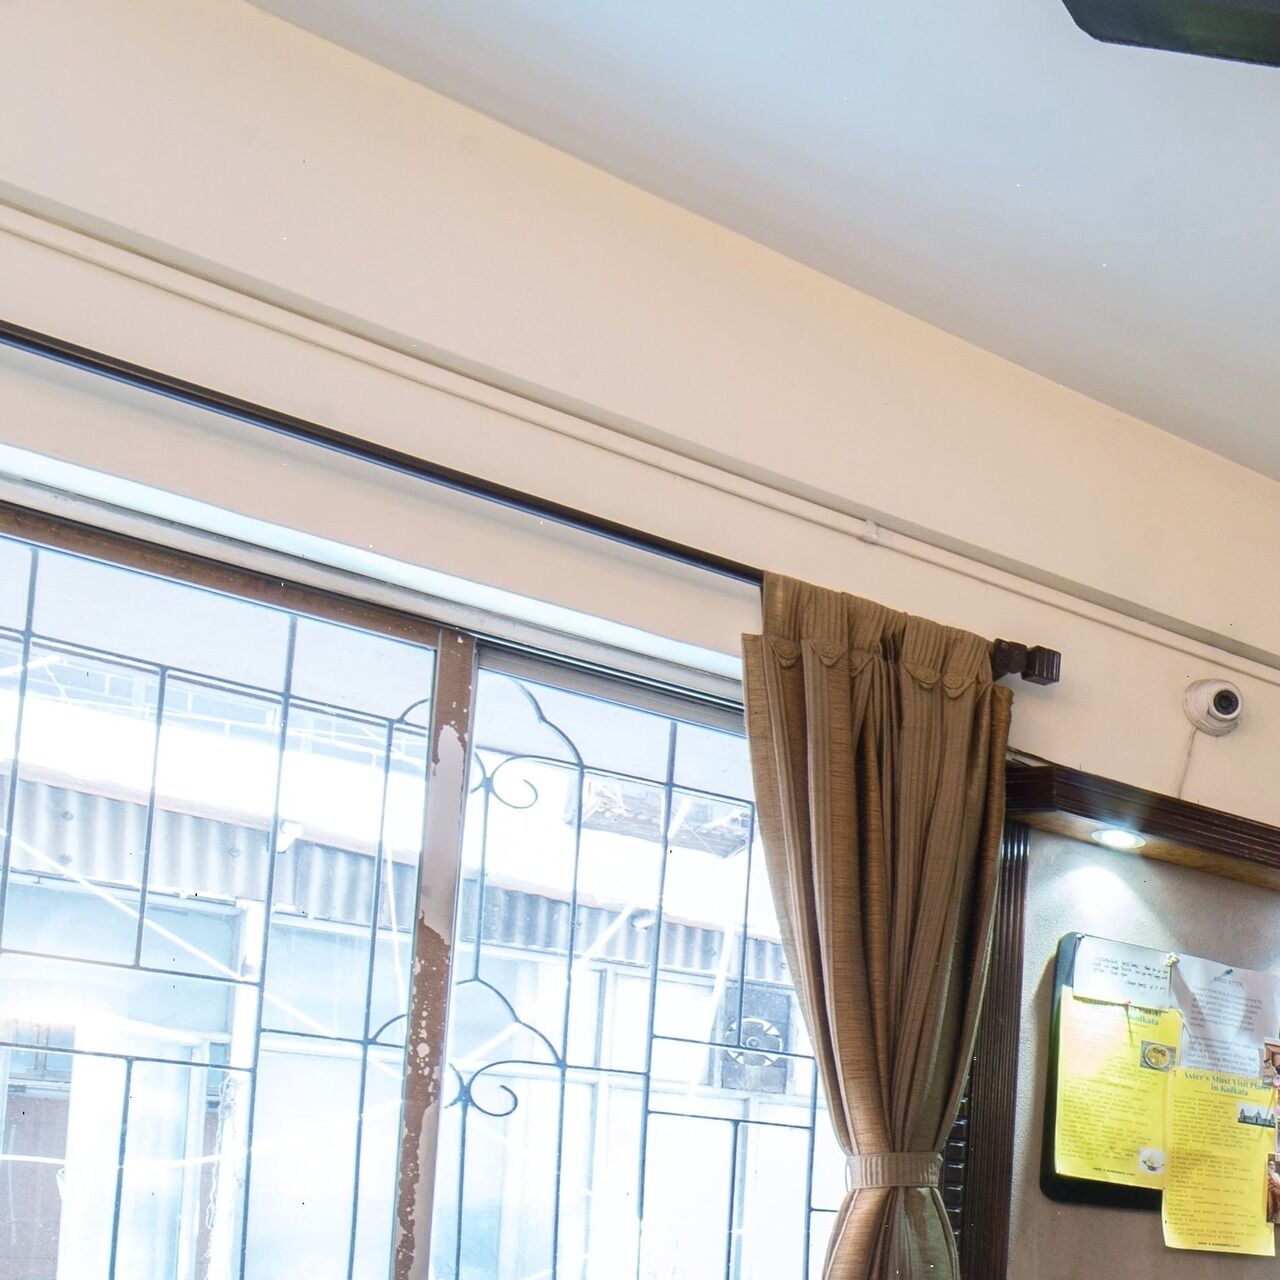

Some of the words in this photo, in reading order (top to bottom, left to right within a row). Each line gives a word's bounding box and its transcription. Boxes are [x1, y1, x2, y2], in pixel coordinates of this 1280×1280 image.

[1212, 1075, 1231, 1085] Must
[1231, 1078, 1248, 1088] Visit
[1210, 1083, 1219, 1092] in
